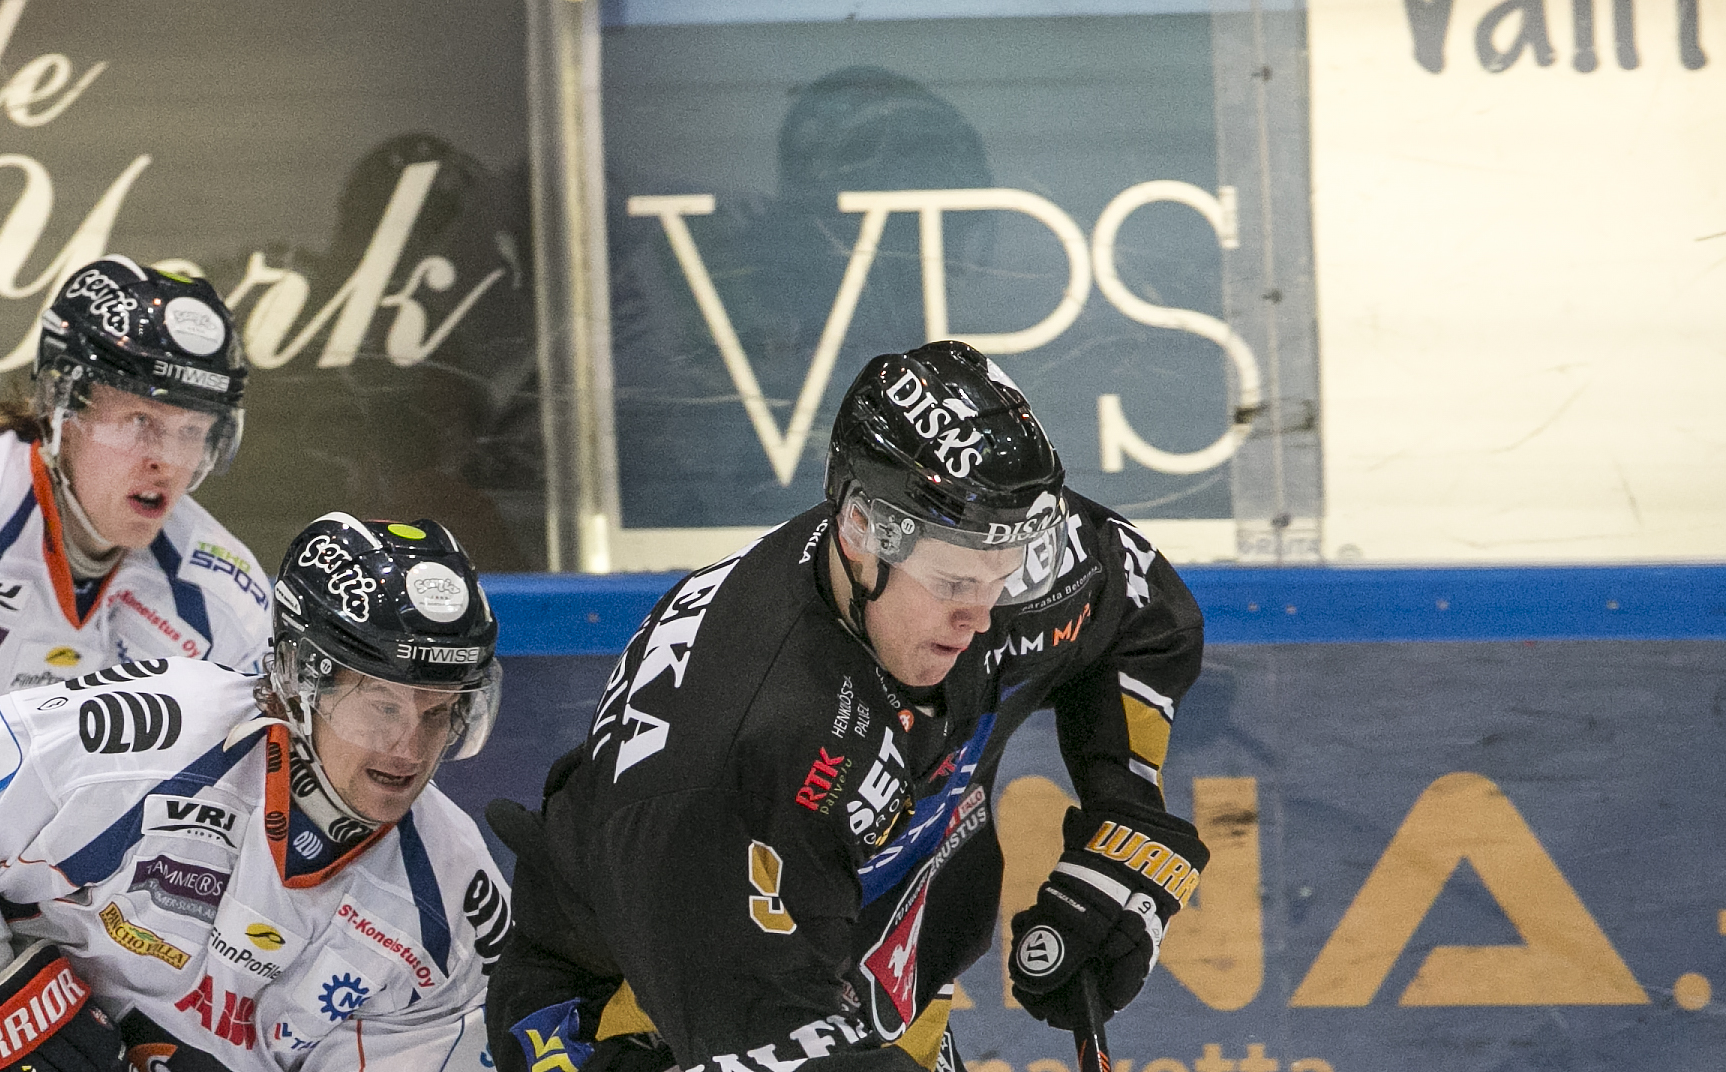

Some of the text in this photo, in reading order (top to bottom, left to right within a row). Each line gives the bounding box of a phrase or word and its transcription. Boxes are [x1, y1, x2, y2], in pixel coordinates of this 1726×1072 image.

[627, 179, 1261, 487] VPS
[153, 359, 231, 392] BITWISE
[798, 518, 829, 565] CKLA
[396, 643, 480, 665] BITWISE
[795, 746, 845, 811] RTK
[165, 800, 237, 832] VRJ
[1084, 820, 1202, 910] WARR
